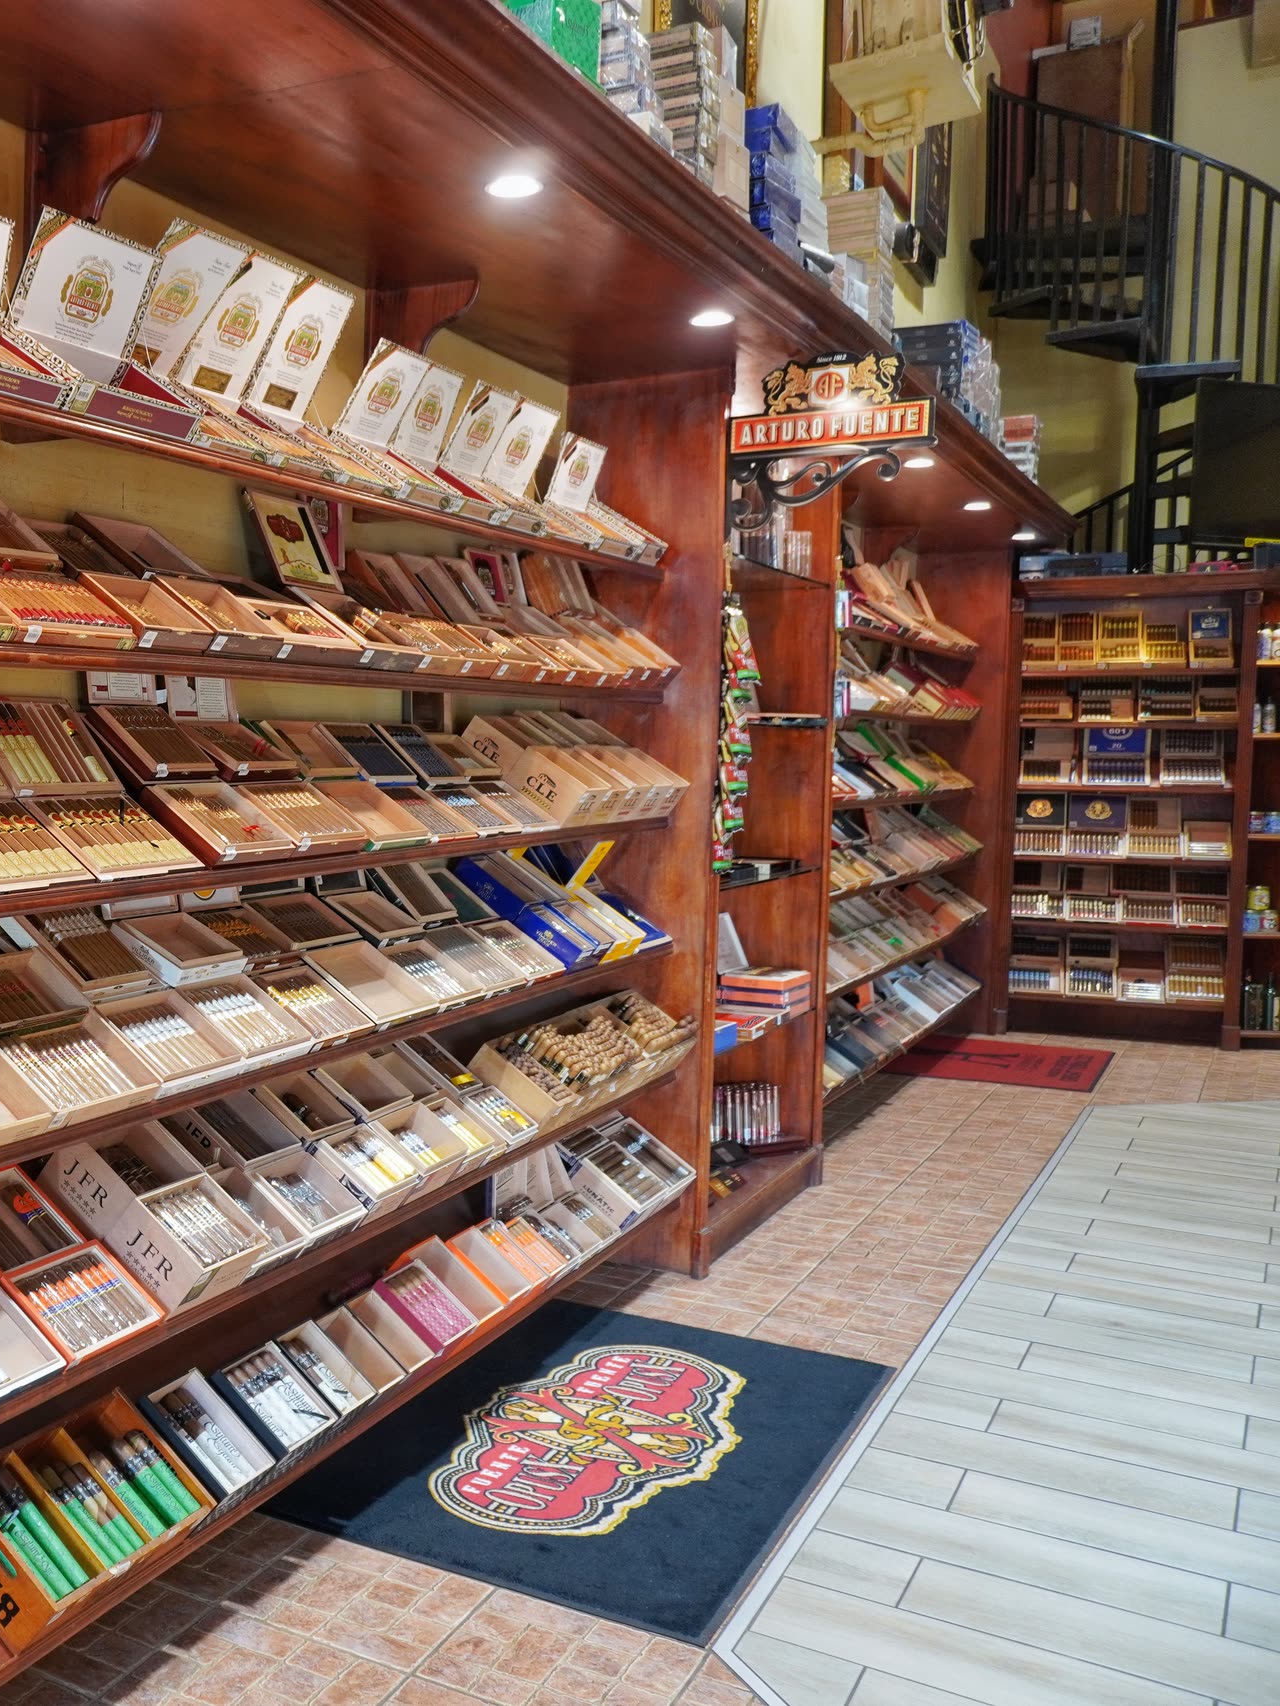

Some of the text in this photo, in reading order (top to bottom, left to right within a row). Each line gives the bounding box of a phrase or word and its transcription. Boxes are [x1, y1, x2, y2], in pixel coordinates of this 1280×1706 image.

[832, 354, 847, 362] 1912
[739, 407, 920, 447] ARTURO FUENTE
[473, 739, 501, 763] CLE
[526, 775, 559, 803] CLE
[131, 945, 156, 966] VILLIGER
[63, 1158, 109, 1209] JFR
[581, 1184, 616, 1215] LUNATIC
[126, 1228, 174, 1282] JFR
[577, 1355, 632, 1396] FUENTE
[461, 1445, 531, 1495] FUENTE
